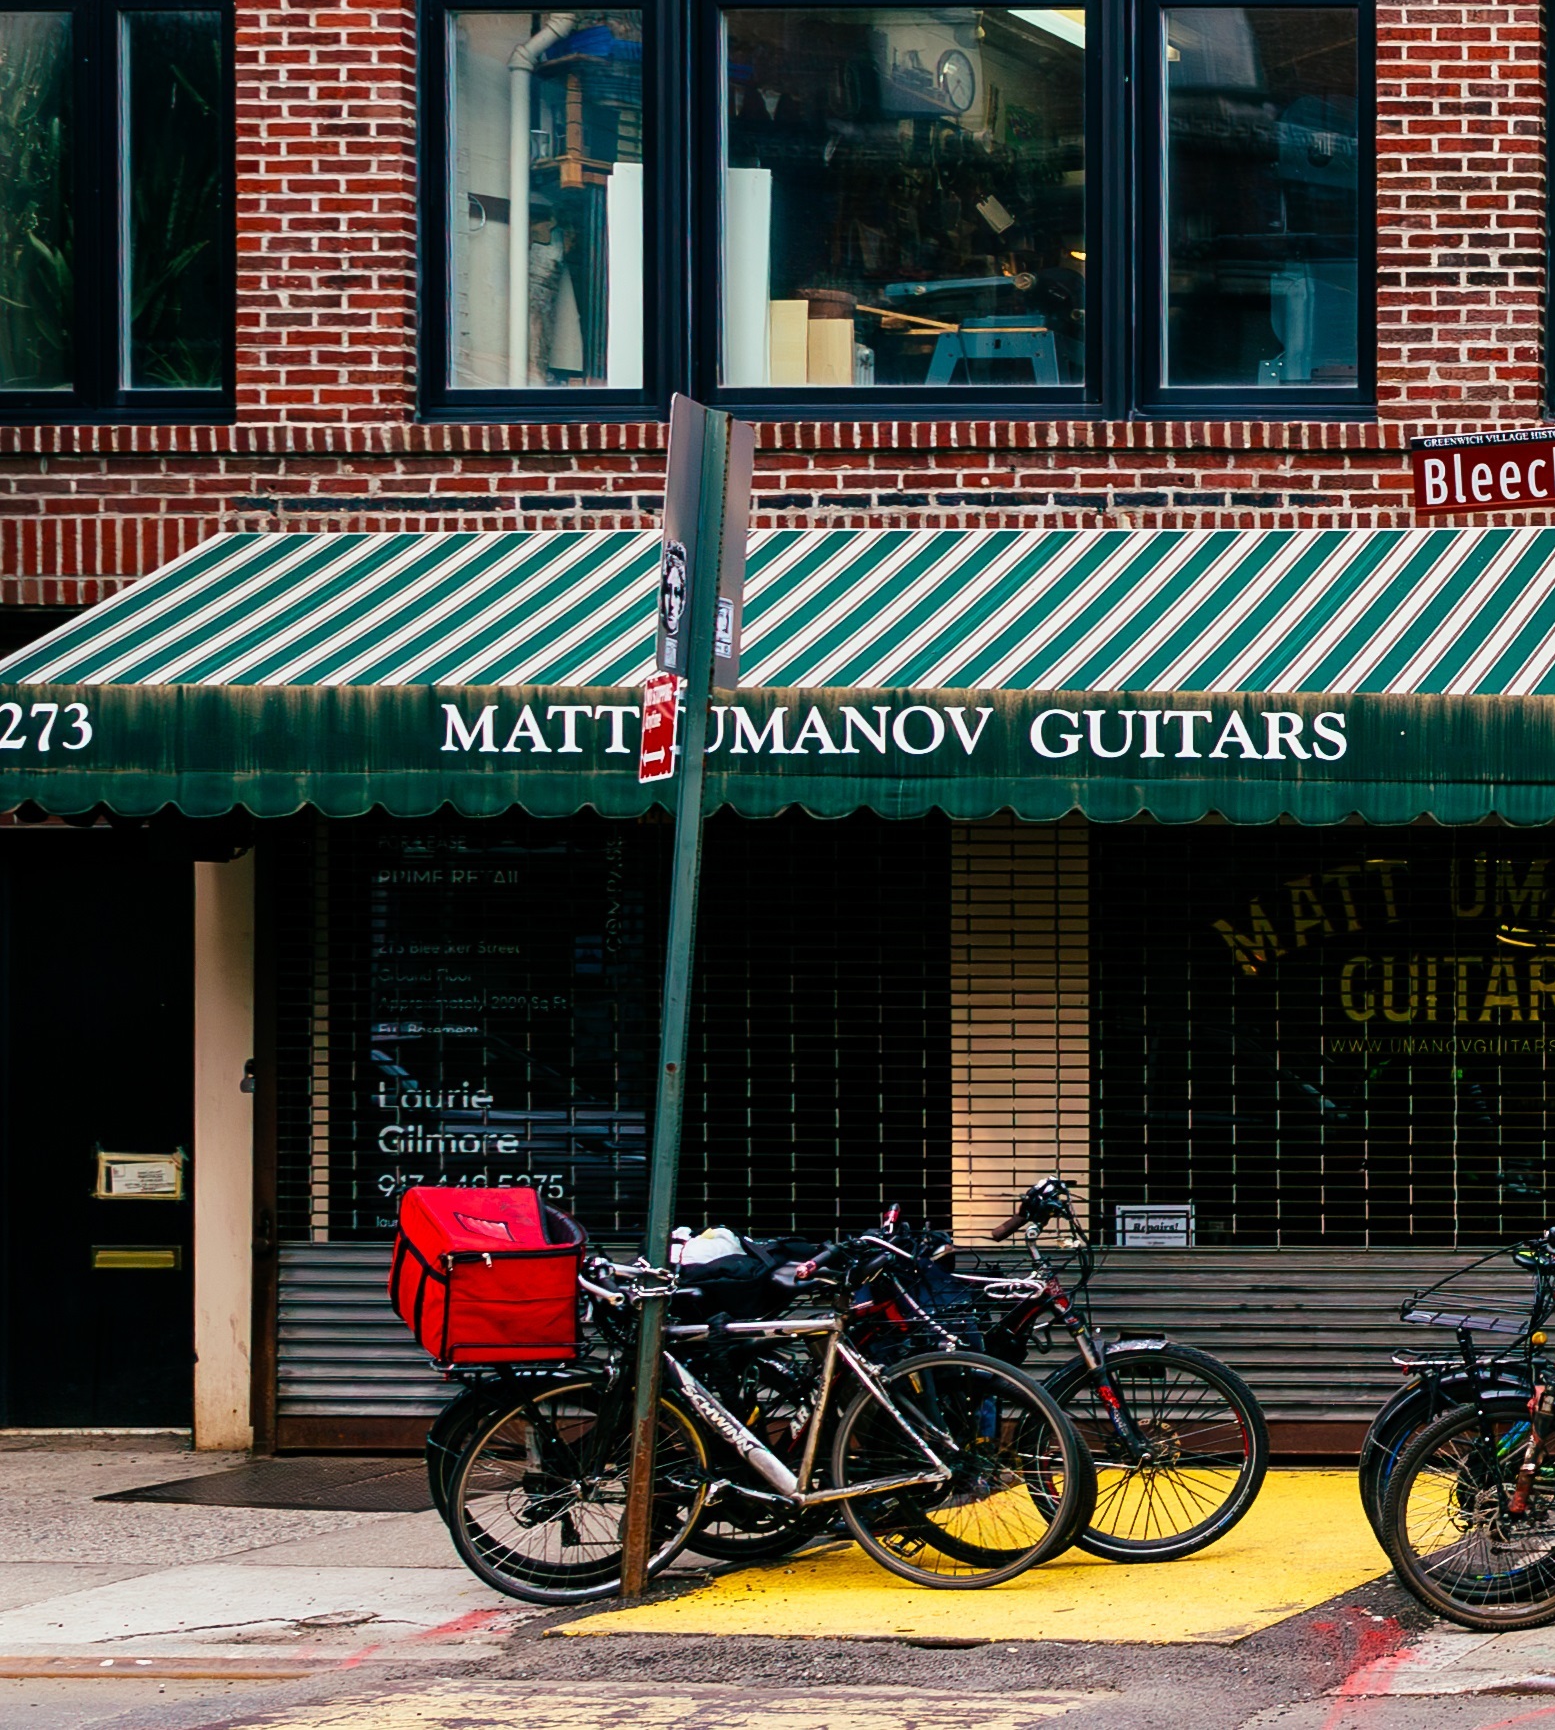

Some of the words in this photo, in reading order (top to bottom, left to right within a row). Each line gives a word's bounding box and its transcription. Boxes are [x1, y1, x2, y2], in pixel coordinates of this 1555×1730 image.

[1424, 434, 1483, 448] GREENWICH
[1486, 431, 1529, 444] VILLAGE
[0, 702, 93, 752] 273
[440, 703, 640, 754] MATT
[1029, 707, 1349, 762] GUITARS
[452, 870, 518, 884] REAIL
[1210, 858, 1408, 976] MATT
[378, 1081, 494, 1110] Laurie
[377, 1124, 519, 1154] Gilmore
[681, 1384, 754, 1453] SCHWINN
